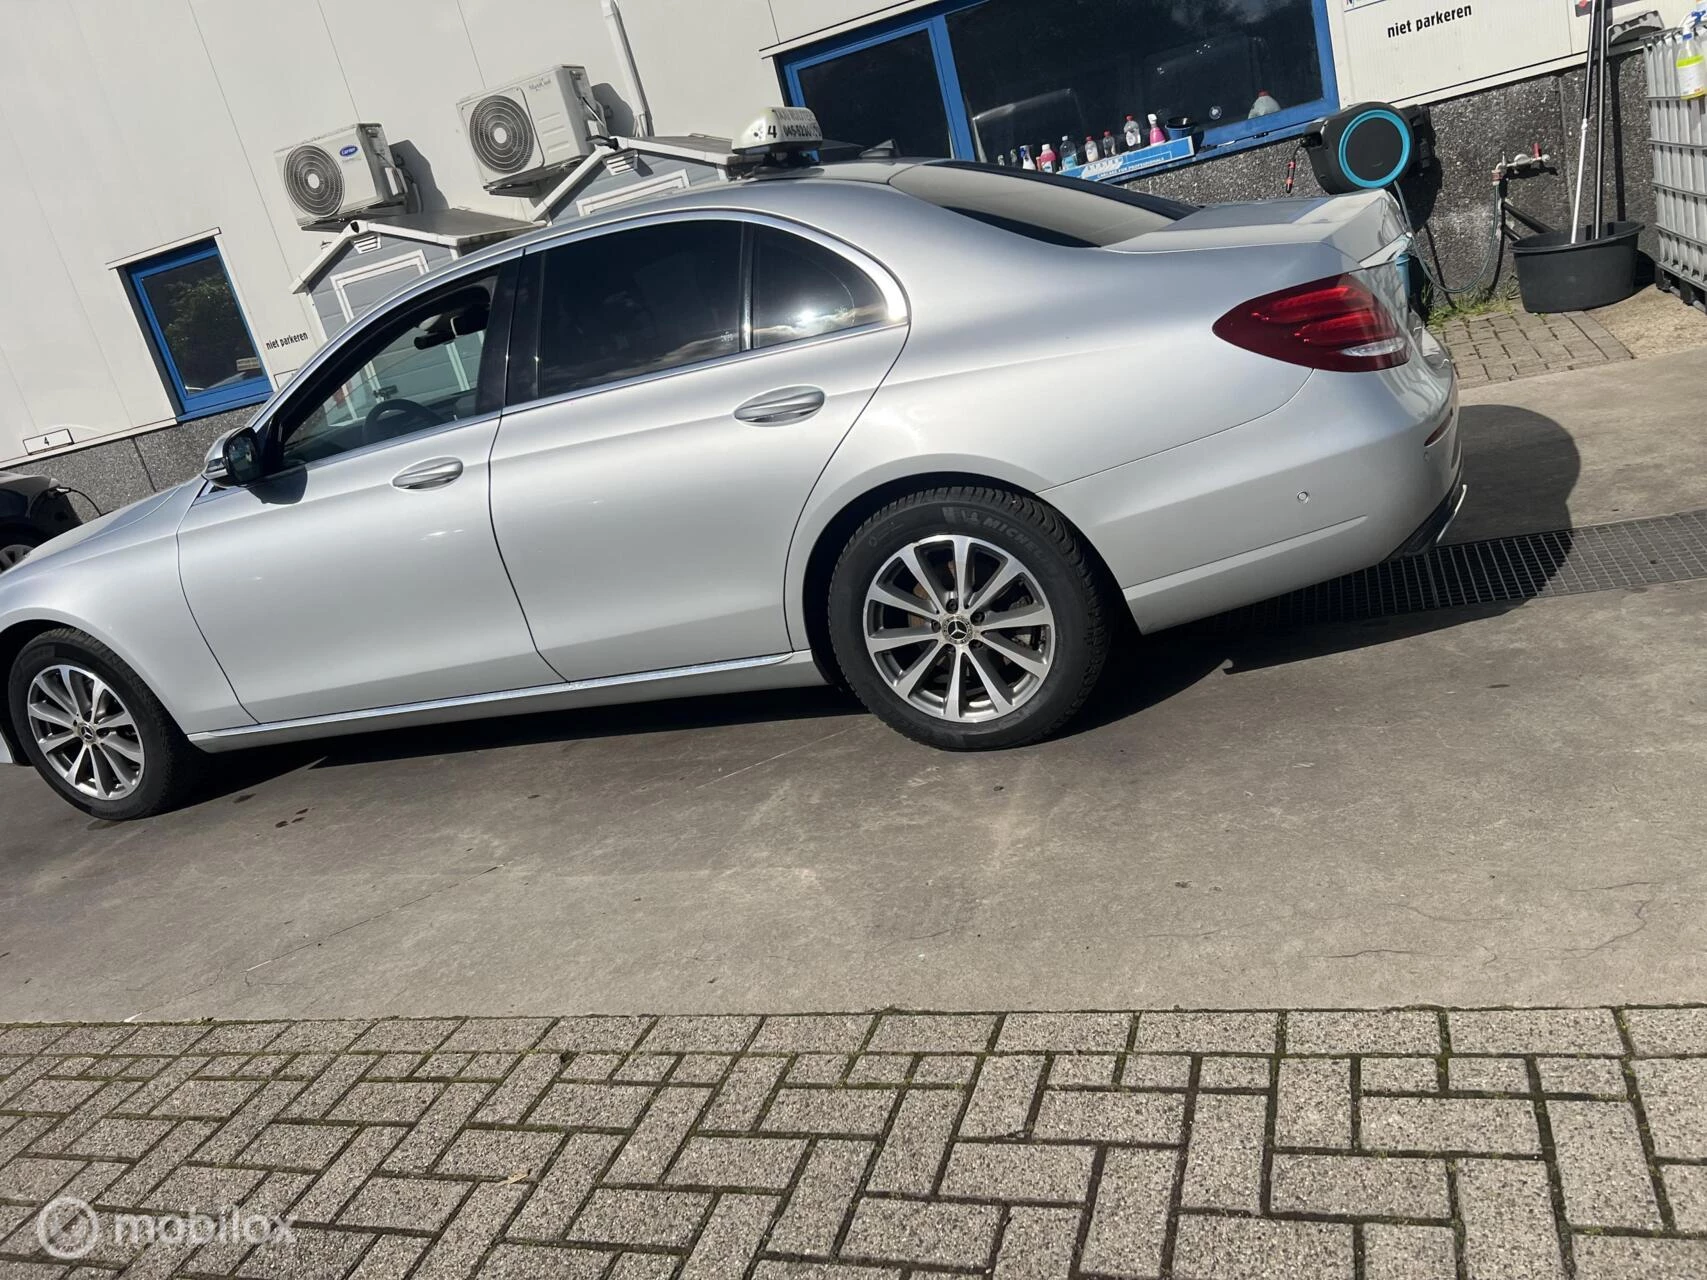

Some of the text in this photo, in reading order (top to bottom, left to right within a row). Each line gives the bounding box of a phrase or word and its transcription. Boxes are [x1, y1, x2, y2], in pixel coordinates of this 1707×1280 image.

[1387, 5, 1472, 38] niet parkeren
[767, 125, 777, 138] 4
[266, 332, 309, 350] niet parkeren
[44, 436, 50, 446] 4
